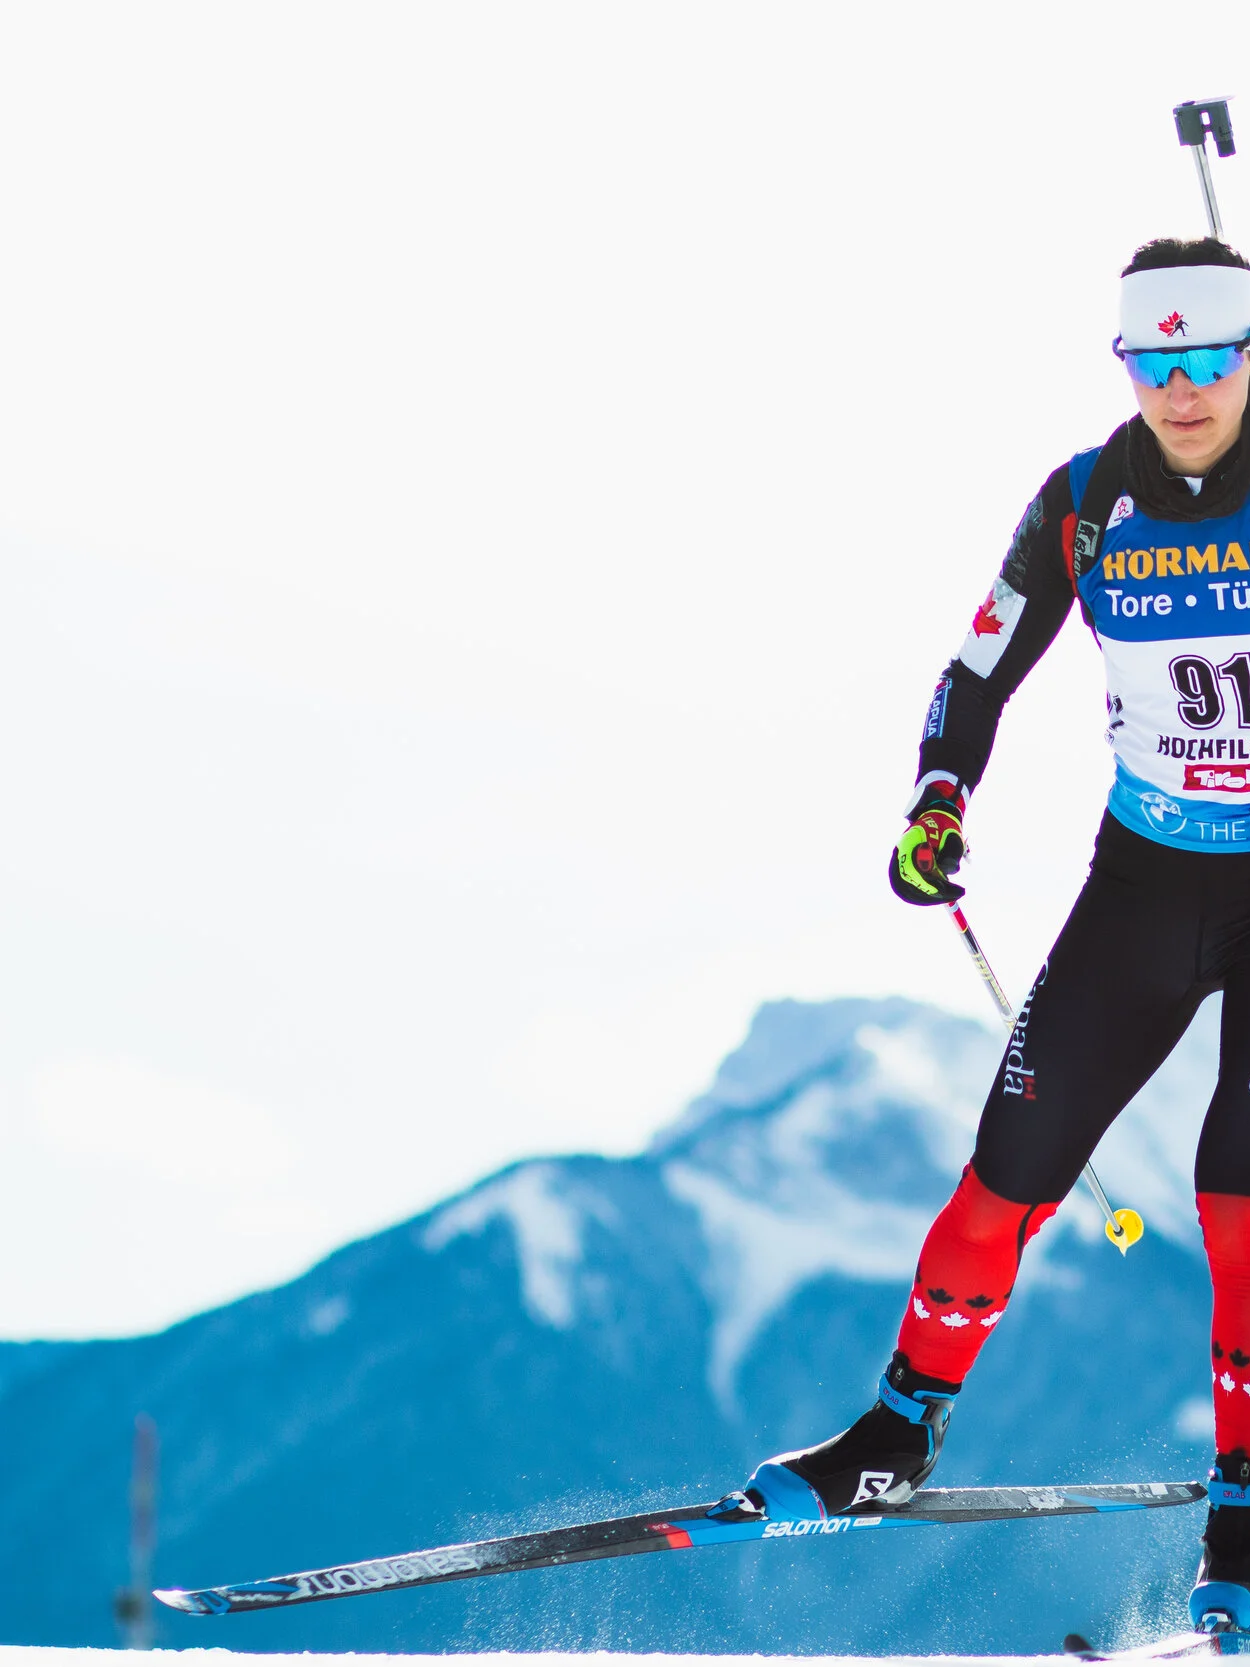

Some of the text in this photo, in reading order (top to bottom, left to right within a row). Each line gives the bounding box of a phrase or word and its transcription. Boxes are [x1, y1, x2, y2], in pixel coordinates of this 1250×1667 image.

[1104, 589, 1173, 618] Tore
[1194, 820, 1247, 841] THE
[761, 1517, 852, 1539] salomon
